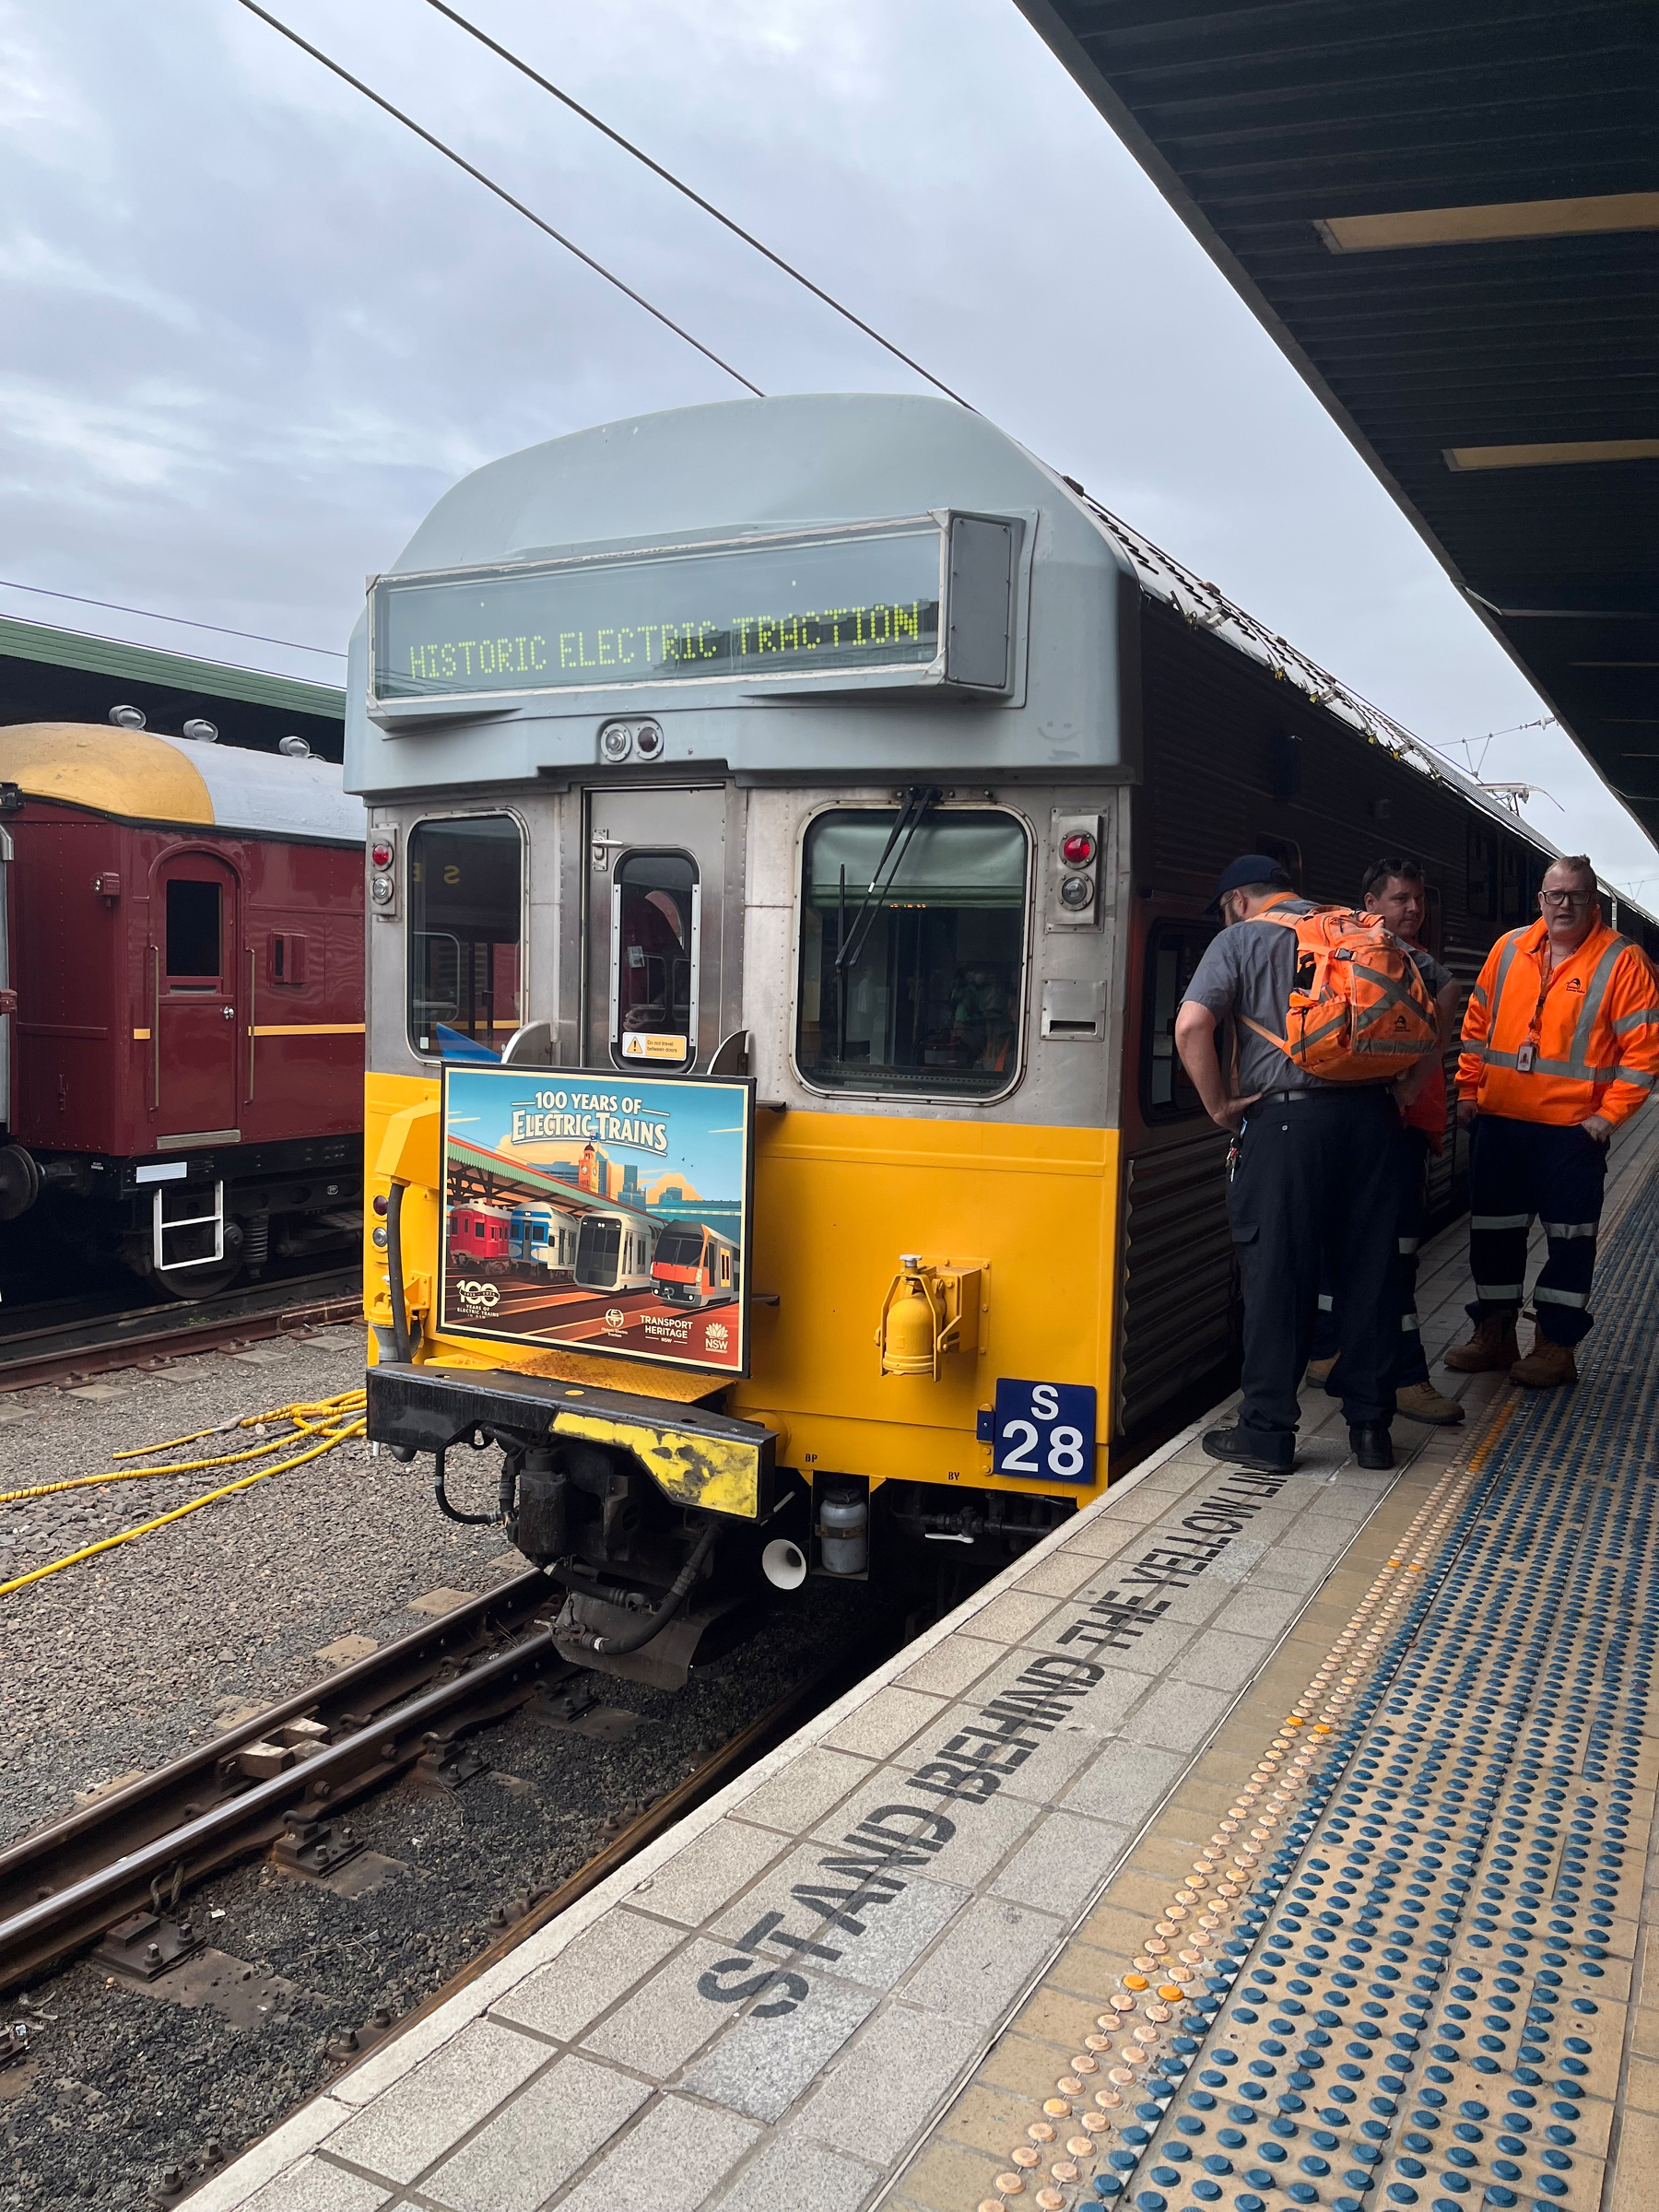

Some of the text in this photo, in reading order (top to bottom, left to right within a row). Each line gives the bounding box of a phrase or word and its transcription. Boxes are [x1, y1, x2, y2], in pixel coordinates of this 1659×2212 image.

[410, 601, 918, 678] HISTORIC ELECTRIC TRACTION
[535, 1091, 642, 1115] 100 YEARS OF
[512, 1110, 667, 1151] ELECTRIC TRAINS
[457, 1307, 479, 1315] ELECTRIC
[640, 1314, 693, 1330] TRANSPORT
[645, 1325, 688, 1339] HERITAGE
[705, 1338, 728, 1350] NSW
[1030, 1384, 1059, 1420] S
[805, 1453, 818, 1464] BP
[1001, 1419, 1085, 1476] 28
[697, 1804, 958, 2018] STAND
[903, 1655, 1106, 1805] BEHIND
[1055, 1591, 1171, 1651] THE
[1119, 1495, 1263, 1590] YELLOW
